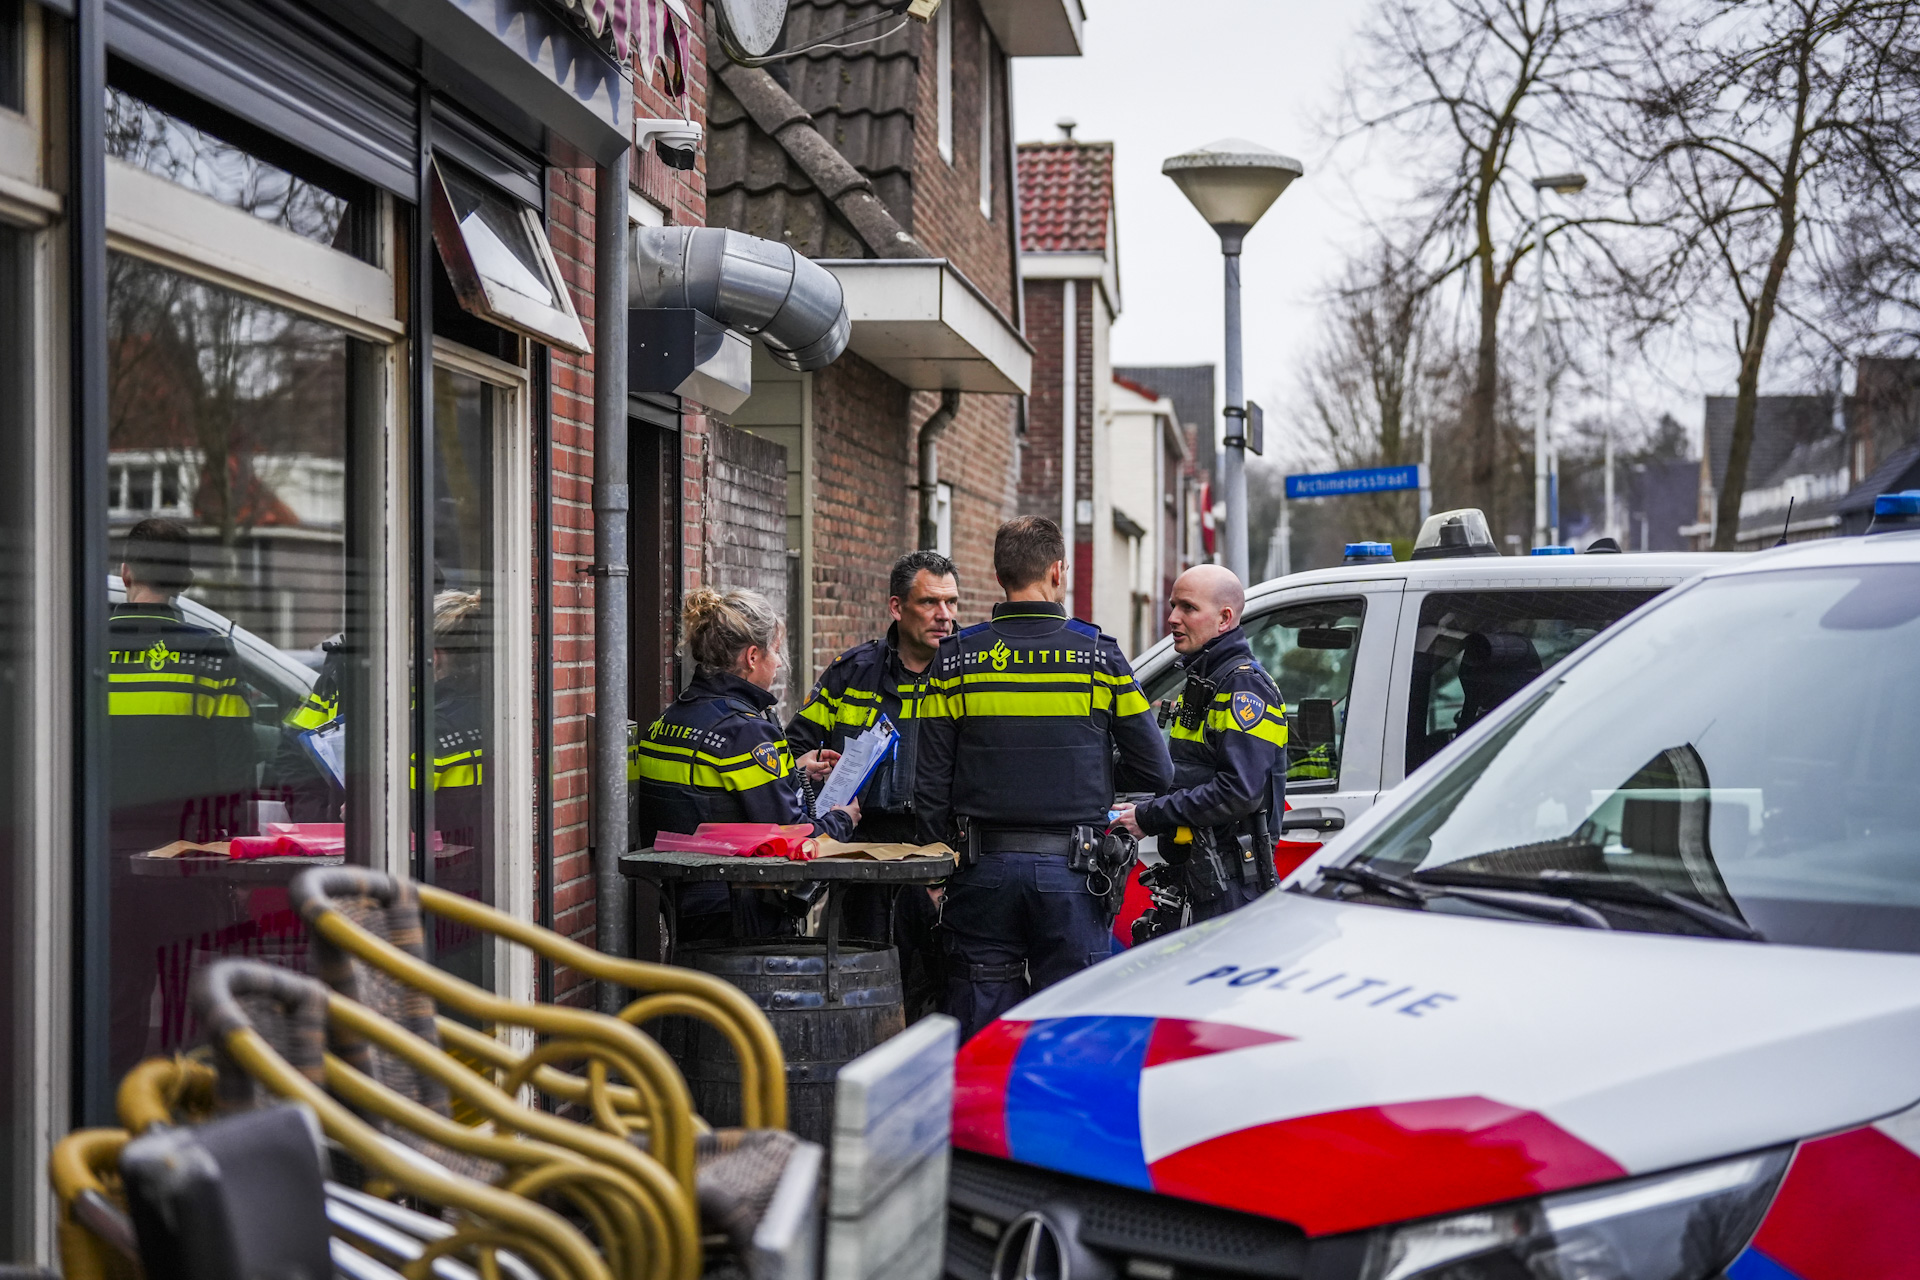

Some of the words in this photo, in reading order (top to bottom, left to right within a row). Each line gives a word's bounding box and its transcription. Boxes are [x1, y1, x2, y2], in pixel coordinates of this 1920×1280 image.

[1295, 472, 1408, 493] Archimedesstraat
[978, 640, 1077, 671] POLITIE
[1236, 694, 1262, 708] POLITIE
[1184, 955, 1459, 1018] POLITIE
